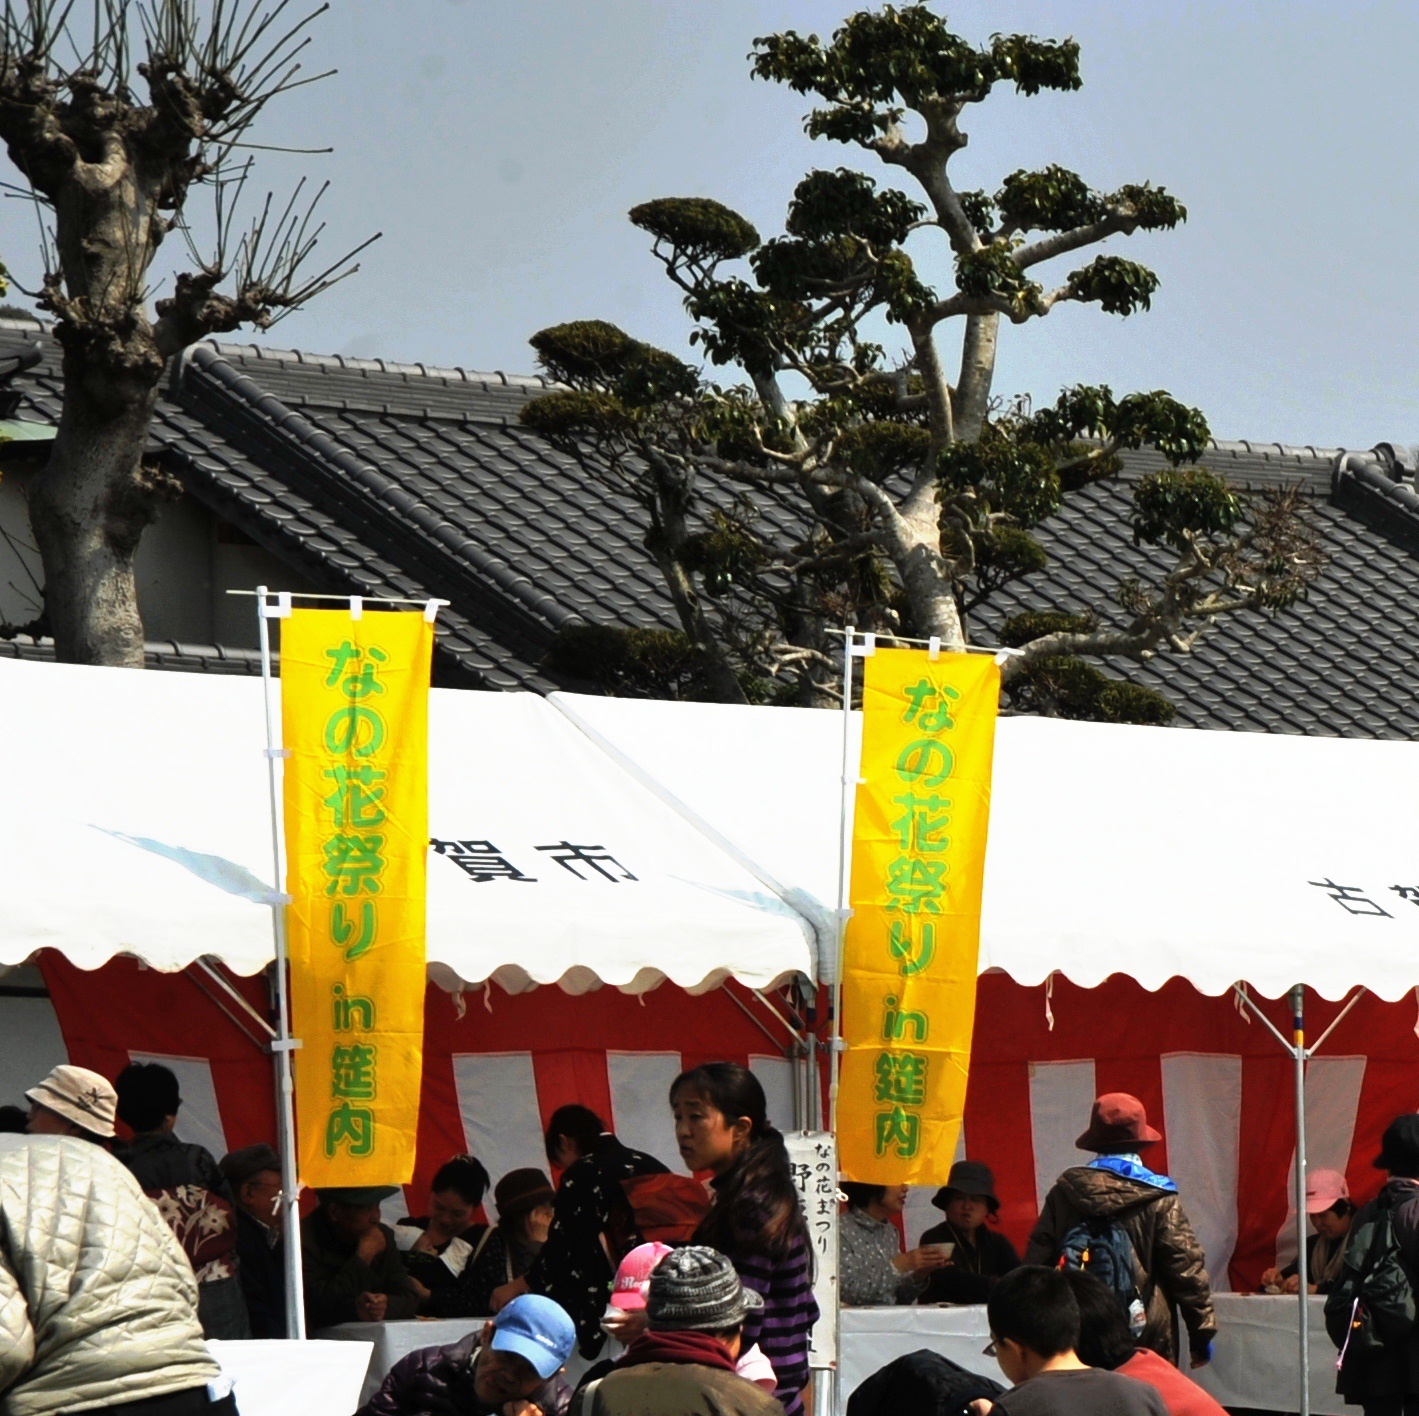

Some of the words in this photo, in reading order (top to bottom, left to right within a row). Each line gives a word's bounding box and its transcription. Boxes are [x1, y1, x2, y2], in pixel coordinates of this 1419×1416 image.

[324, 639, 388, 962] なの花祭り
[886, 677, 962, 976] なの花祭り
[429, 837, 639, 883] 賀市
[332, 984, 376, 1033] in
[883, 995, 928, 1045] in
[325, 1044, 378, 1159] 筵内
[874, 1053, 926, 1159] 筵内
[814, 1142, 833, 1255] なの花まつり
